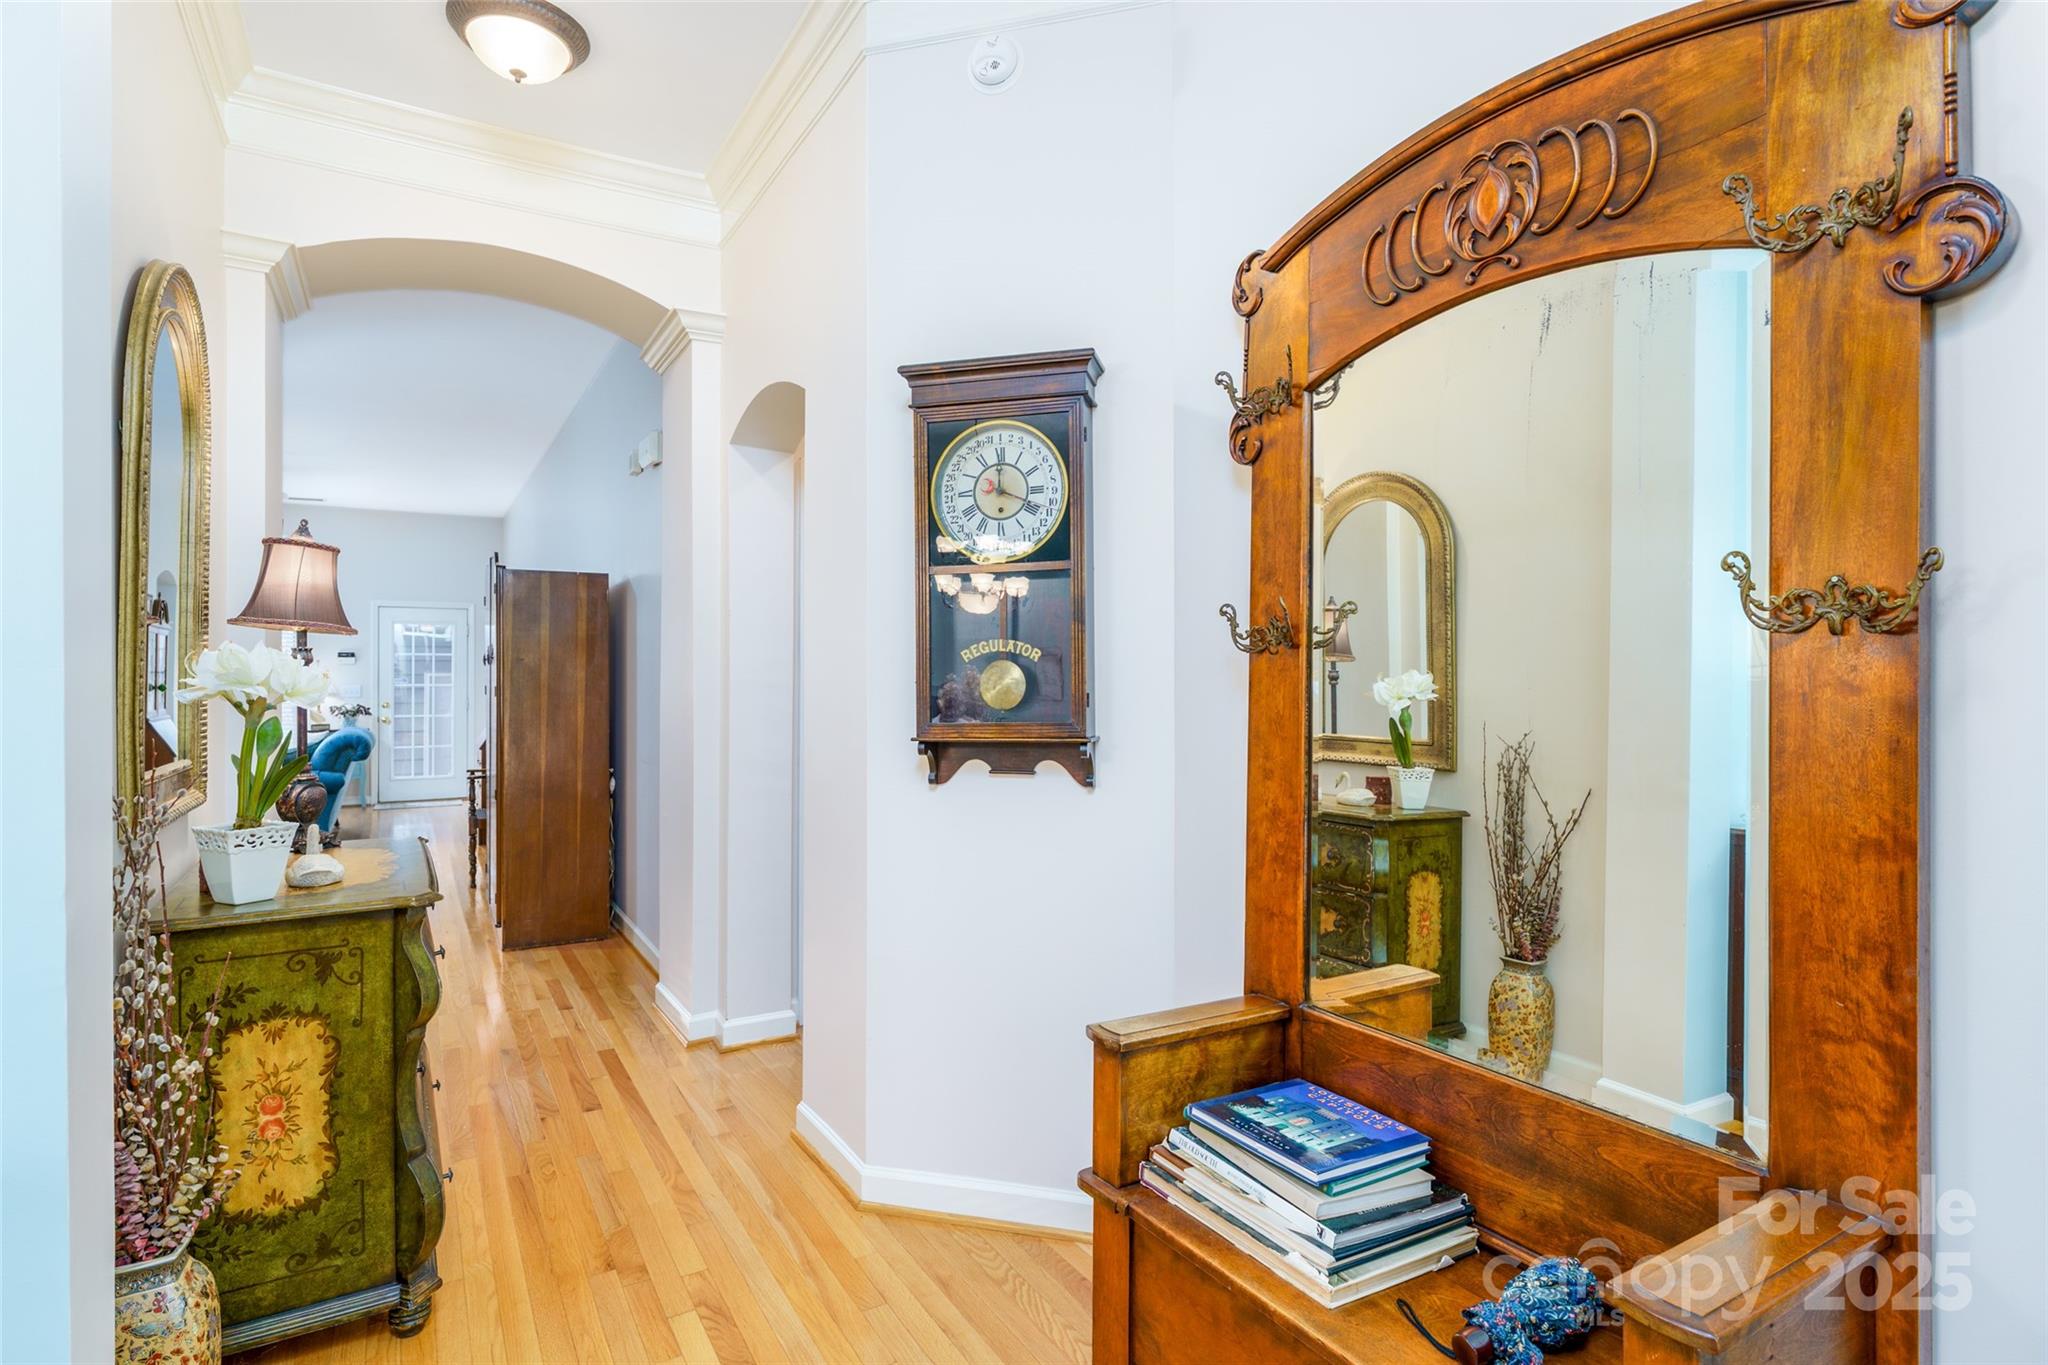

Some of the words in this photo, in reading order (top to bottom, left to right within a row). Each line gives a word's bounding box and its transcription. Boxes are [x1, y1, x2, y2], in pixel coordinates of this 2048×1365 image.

[984, 435, 994, 444] 31
[1008, 434, 1014, 443] 2
[1018, 436, 1024, 444] 3
[974, 439, 985, 448] 30
[1042, 455, 1048, 463] 6
[951, 463, 961, 472] 27
[1051, 486, 1058, 495] 9
[946, 505, 956, 514] 23
[1039, 518, 1048, 527] 12
[1032, 527, 1041, 536] 13
[960, 639, 1042, 663] REGULATOR
[1307, 1093, 1384, 1130] CAPITOLS
[1308, 1085, 1407, 1132] LOUISIANA'S
